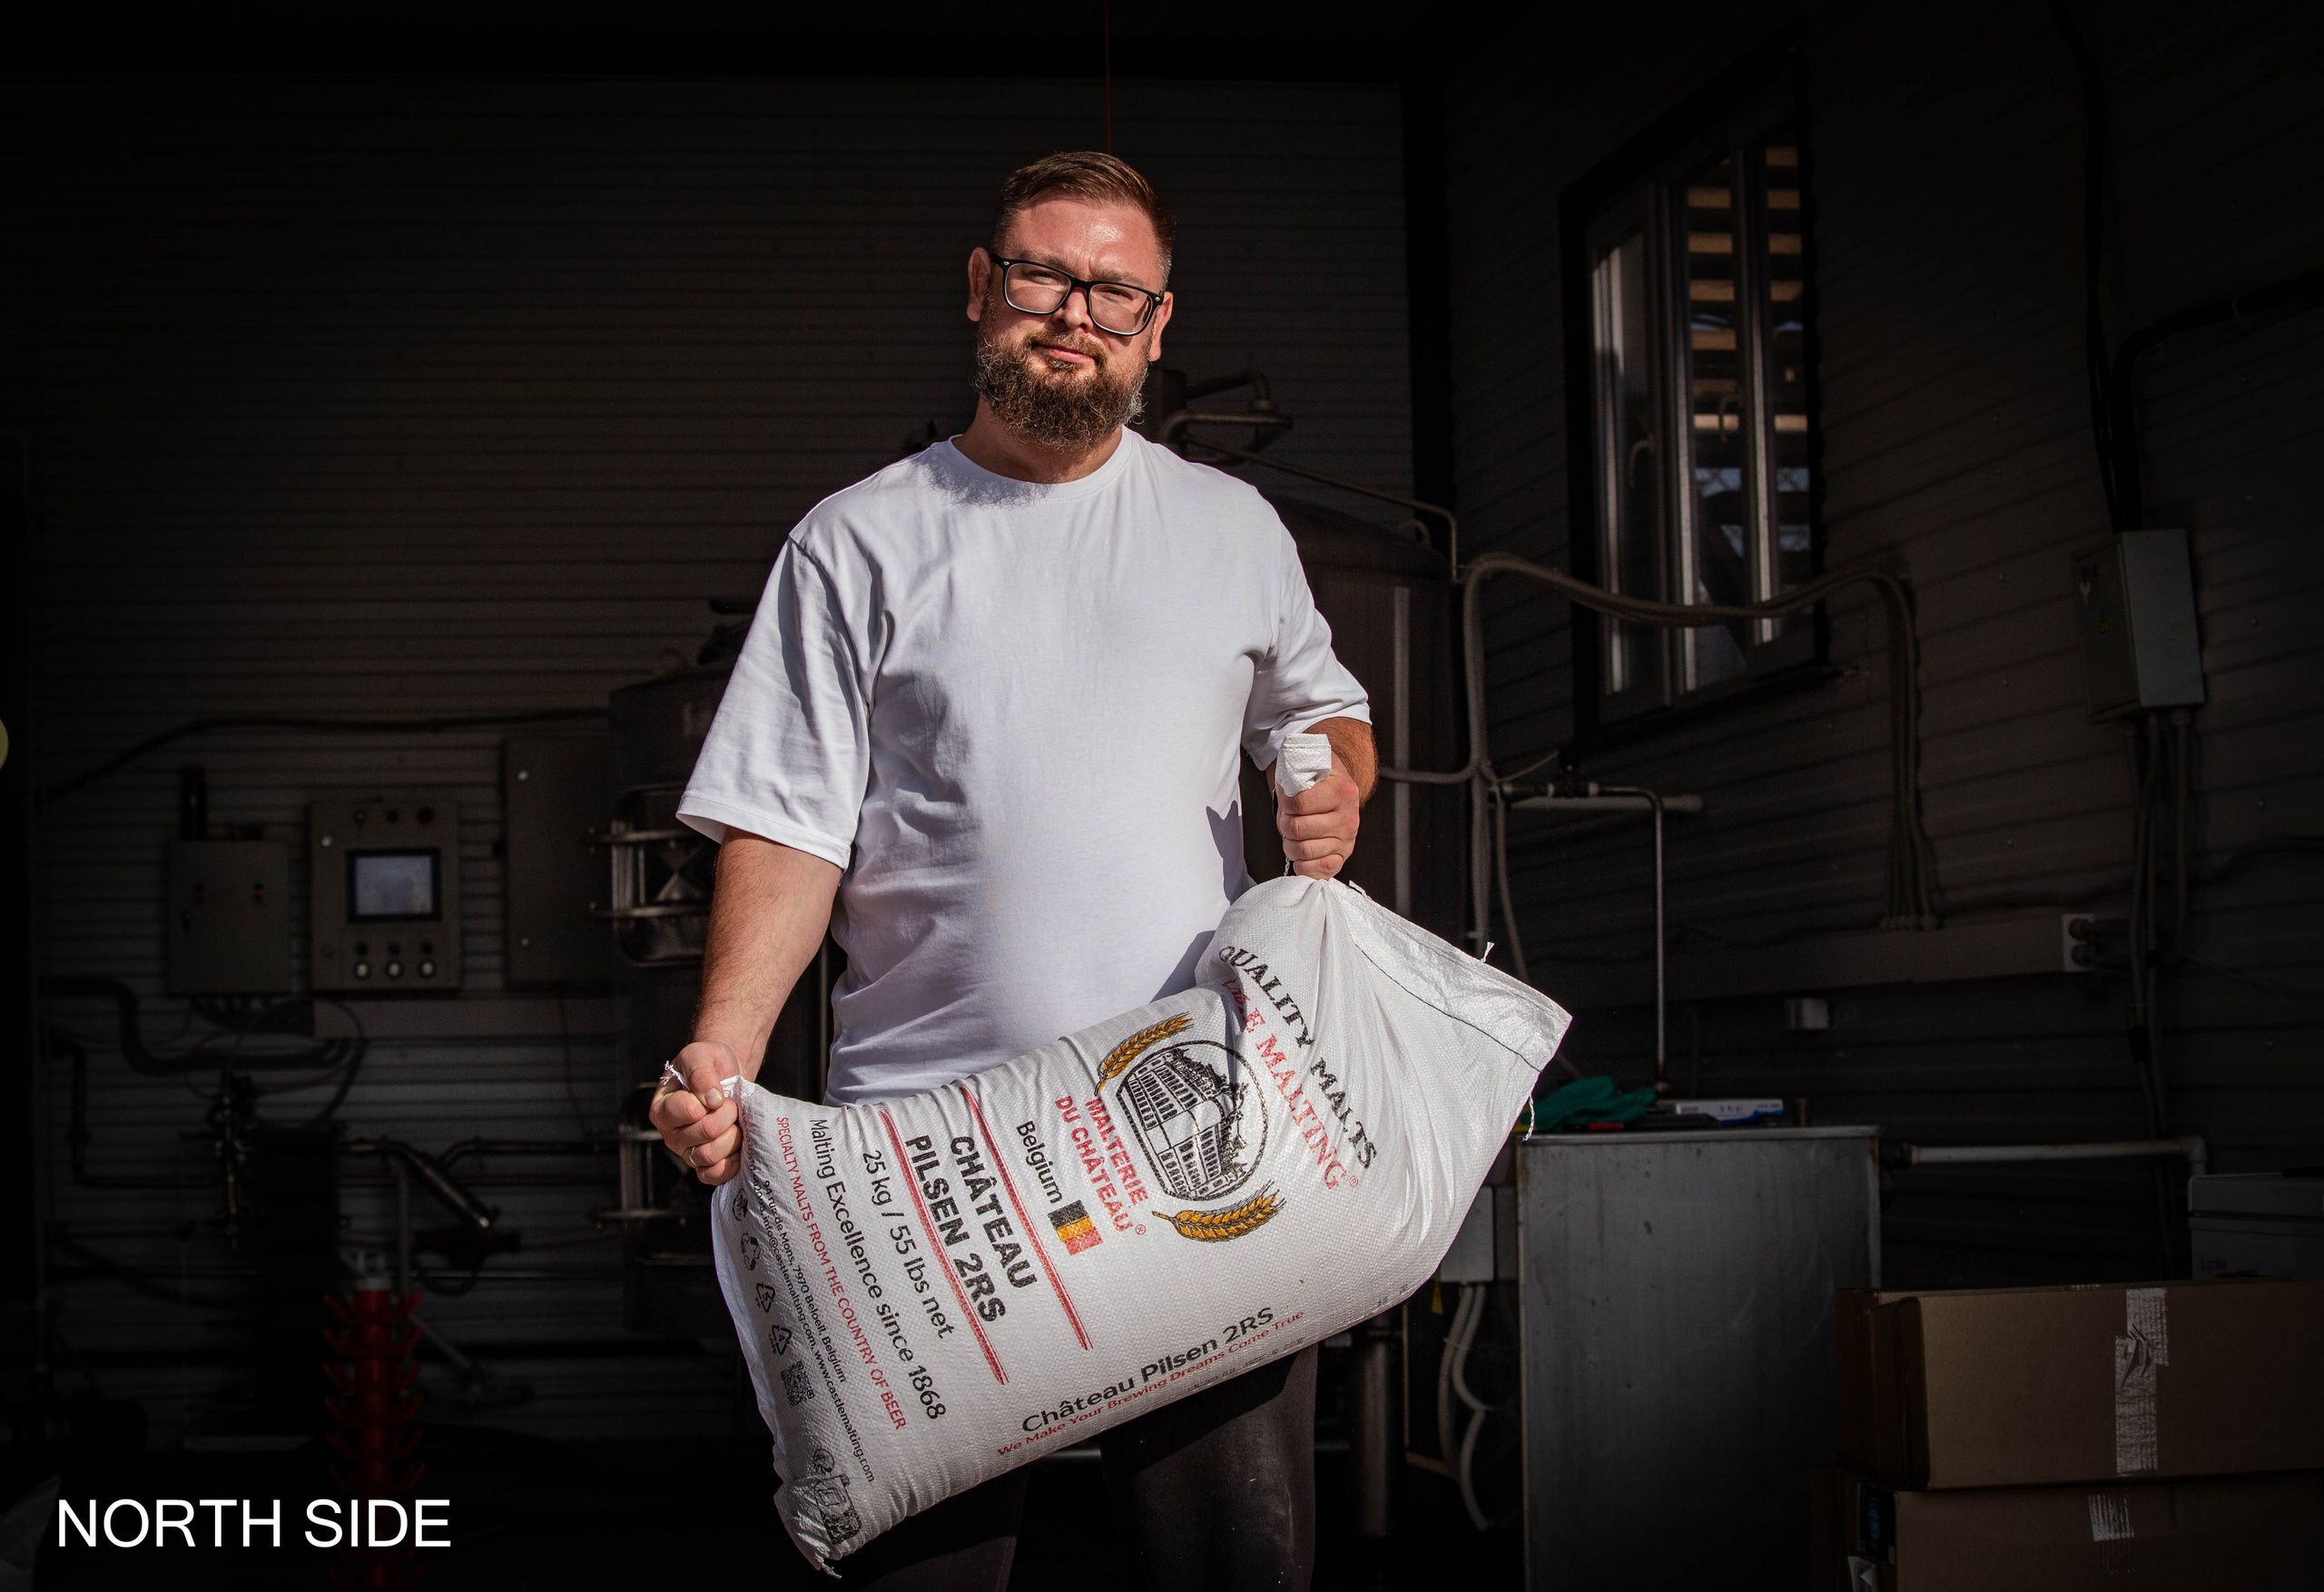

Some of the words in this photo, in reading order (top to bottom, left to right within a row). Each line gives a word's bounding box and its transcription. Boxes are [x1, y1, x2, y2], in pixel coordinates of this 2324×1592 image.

[1218, 946, 1315, 1048] QUALITY
[1310, 1056, 1377, 1169] MALTS
[1256, 1033, 1348, 1191] MALTING
[862, 1149, 887, 1174] 25
[871, 1176, 892, 1207] kg
[950, 1135, 1038, 1289] CHÂTEAU
[1016, 1120, 1062, 1204] Belgium
[1055, 1095, 1081, 1124] DU
[1071, 1128, 1133, 1233] CHÂTEAU
[1085, 1098, 1149, 1206] MALTERIE
[763, 1180, 773, 1194] 94
[773, 1217, 783, 1231] de
[780, 1232, 795, 1265] Mons,
[793, 1264, 810, 1293] 7970
[805, 1294, 827, 1336] Beloeil,
[822, 1336, 847, 1382] Belgium
[776, 1116, 799, 1173] SPECIALTY
[790, 1175, 814, 1223] MALTS
[806, 1223, 832, 1266] FROM
[824, 1266, 844, 1296] THE
[837, 1298, 878, 1365] COUNTRY
[870, 1368, 890, 1389] OF
[881, 1391, 907, 1430] BEER
[809, 1119, 836, 1179] Malting
[826, 1181, 882, 1299] Excellence
[876, 1303, 915, 1362] since
[908, 1364, 947, 1420] 1868
[890, 1224, 917, 1255] 55
[903, 1258, 931, 1294] lbs
[906, 1135, 970, 1248] PILSEN
[954, 1252, 1006, 1323] 2RS
[762, 1215, 815, 1351] info@castlemalting.com,
[814, 1350, 875, 1482] www.castlemalting.com
[922, 1296, 956, 1340] net
[997, 1440, 1022, 1457] We
[1026, 1420, 1066, 1445] Make
[1070, 1407, 1104, 1426] Your
[1108, 1378, 1167, 1410] Brewing
[1170, 1351, 1225, 1382] Dreams
[1228, 1329, 1270, 1354] Come
[1272, 1310, 1305, 1332] True
[1022, 1374, 1136, 1432] Château
[1140, 1339, 1217, 1384] Pilsen
[1223, 1307, 1275, 1344] 2RS
